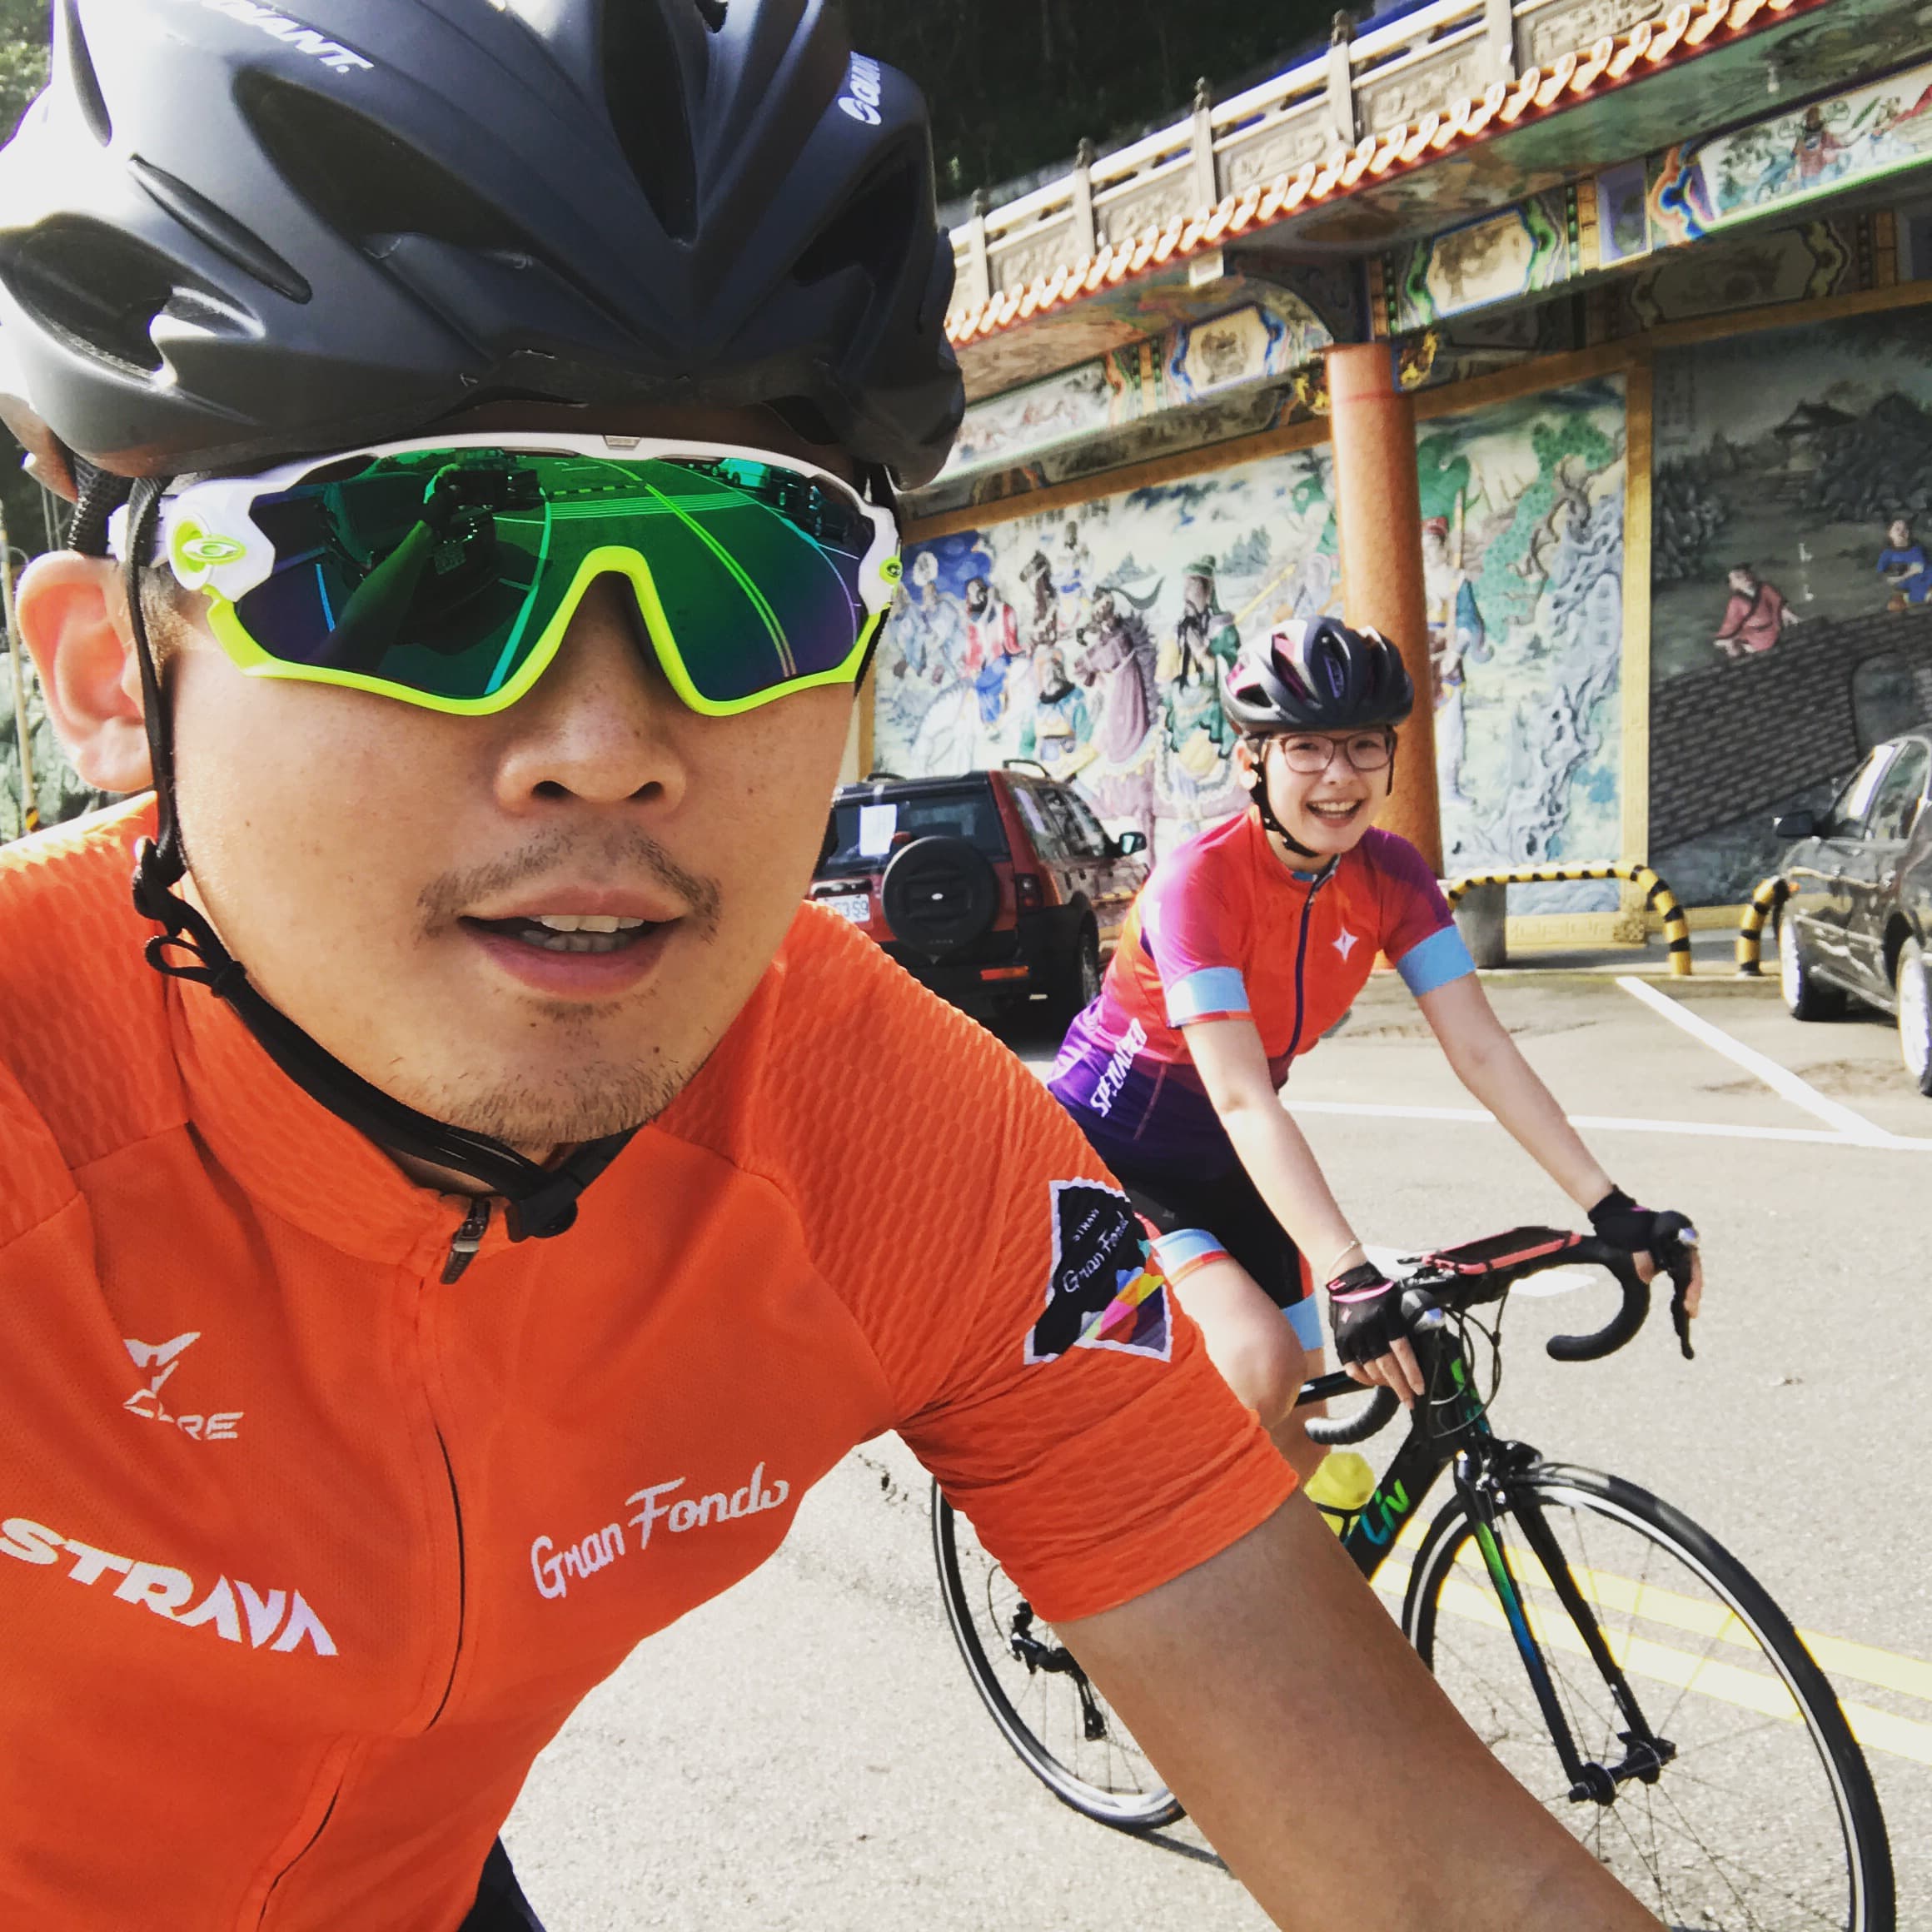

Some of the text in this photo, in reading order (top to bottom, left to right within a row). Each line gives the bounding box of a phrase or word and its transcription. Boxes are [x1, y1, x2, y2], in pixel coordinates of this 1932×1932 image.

[1063, 1252, 1106, 1292] Gran
[0, 1517, 339, 1656] STRAVA
[530, 1461, 790, 1599] Gran Fondo
